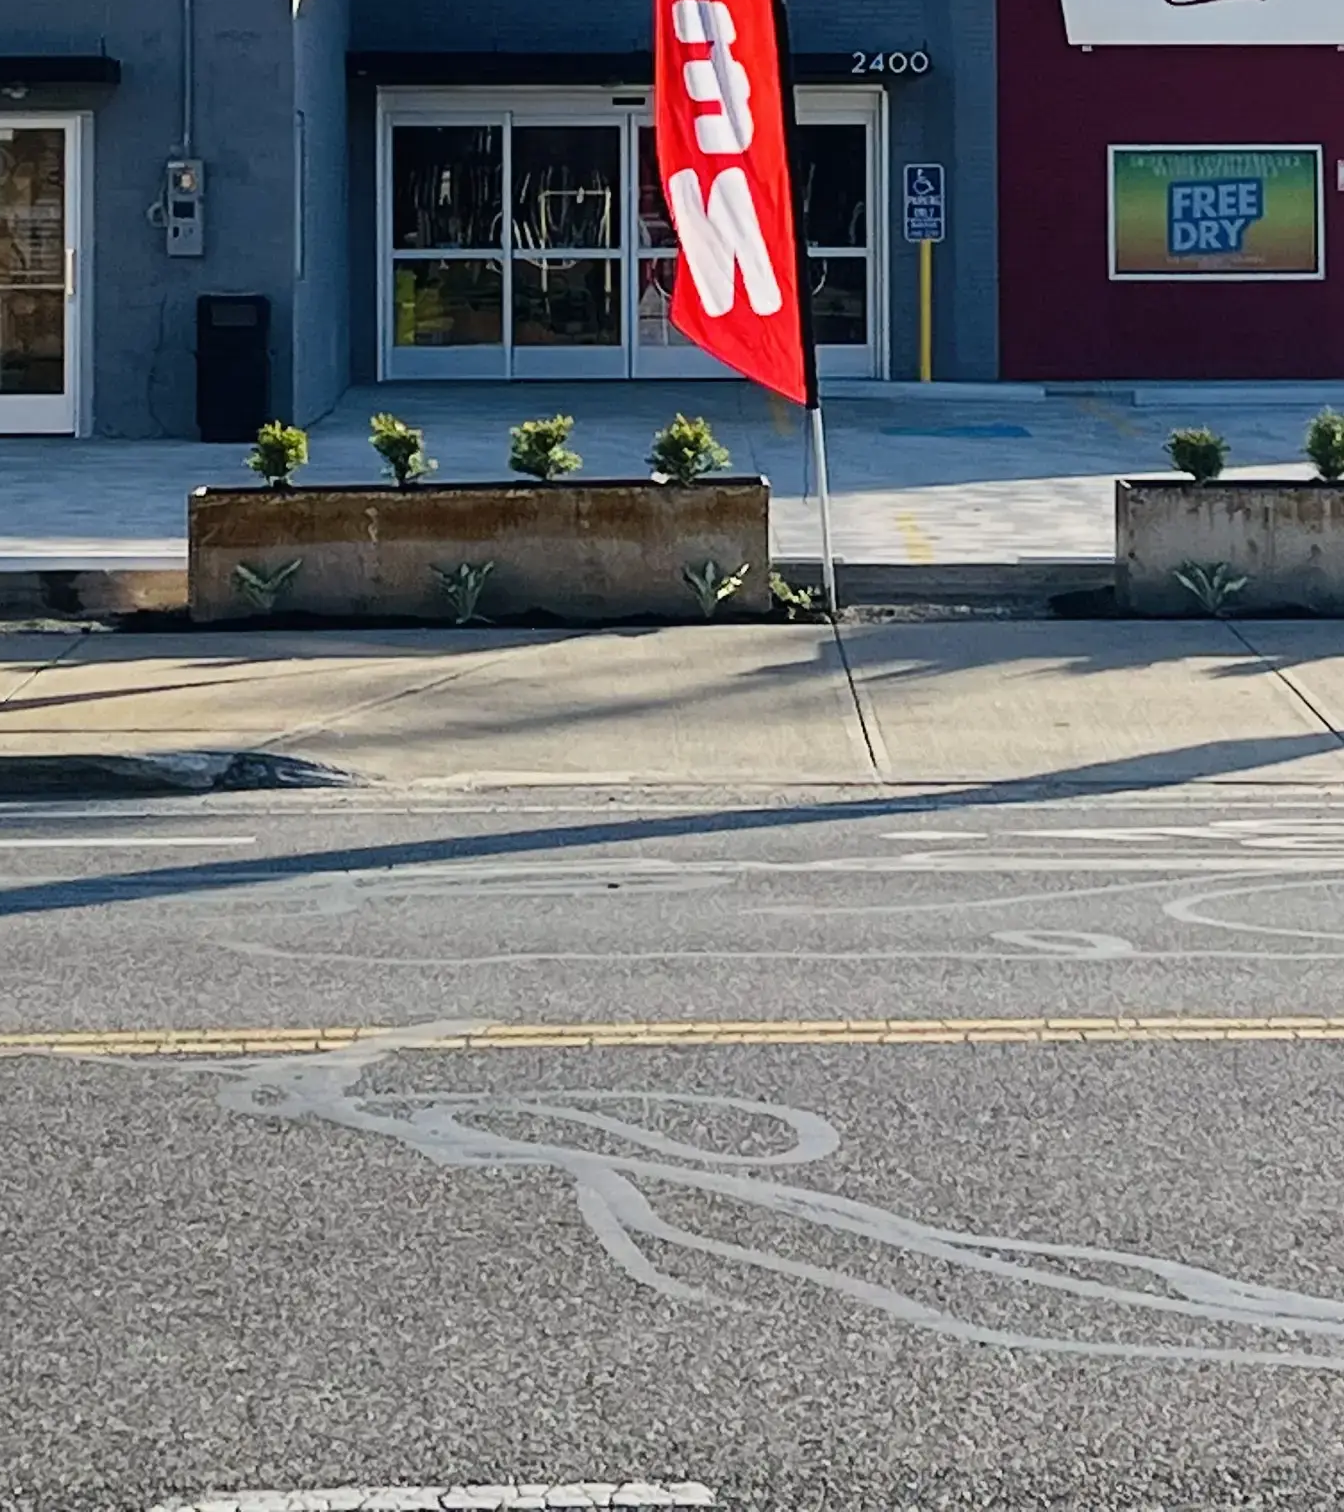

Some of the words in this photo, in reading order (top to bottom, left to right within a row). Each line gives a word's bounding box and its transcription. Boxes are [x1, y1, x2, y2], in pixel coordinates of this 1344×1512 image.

[851, 51, 929, 73] 2400
[1172, 183, 1257, 219] FREE
[1172, 218, 1246, 252] DRY
